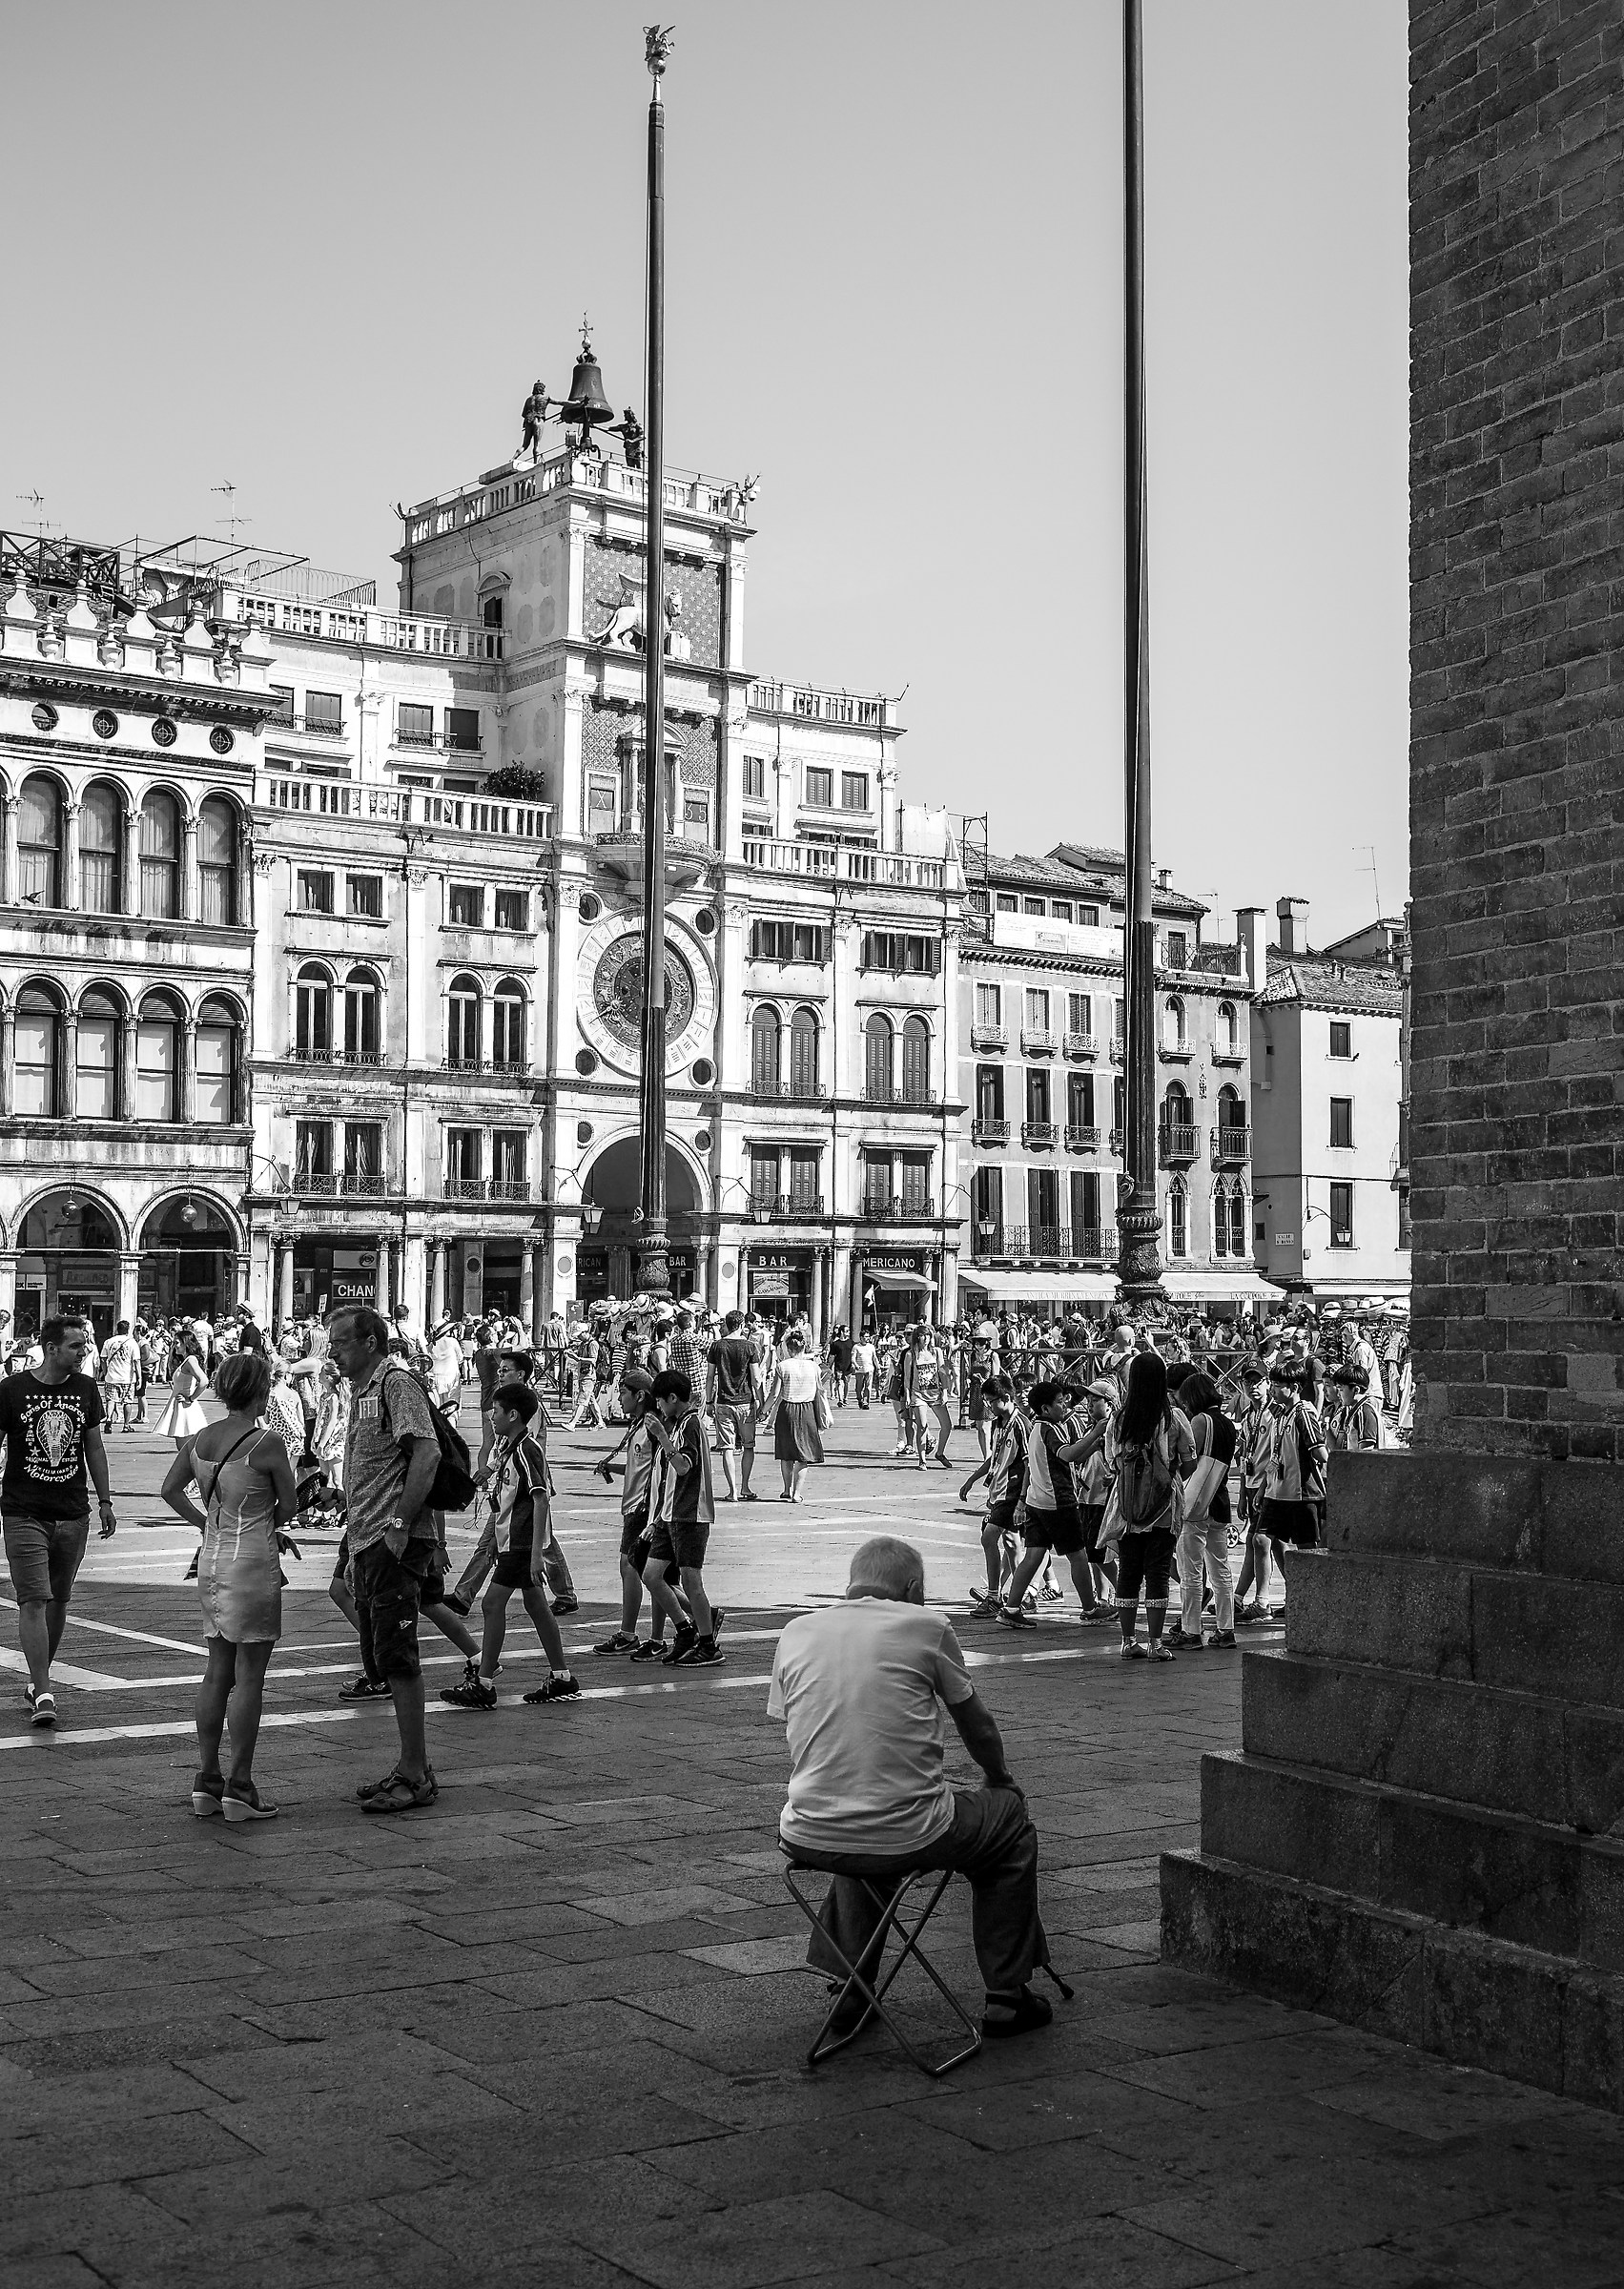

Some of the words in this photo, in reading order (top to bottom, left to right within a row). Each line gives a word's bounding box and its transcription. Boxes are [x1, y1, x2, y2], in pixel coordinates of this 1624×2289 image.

[577, 1257, 602, 1268] RICAN
[669, 1256, 686, 1267] BAR
[759, 1256, 787, 1267] BAR
[863, 1257, 915, 1268] MERICANO
[338, 1285, 376, 1297] CHAN
[20, 1404, 41, 1424] Sons
[40, 1399, 53, 1410] Of
